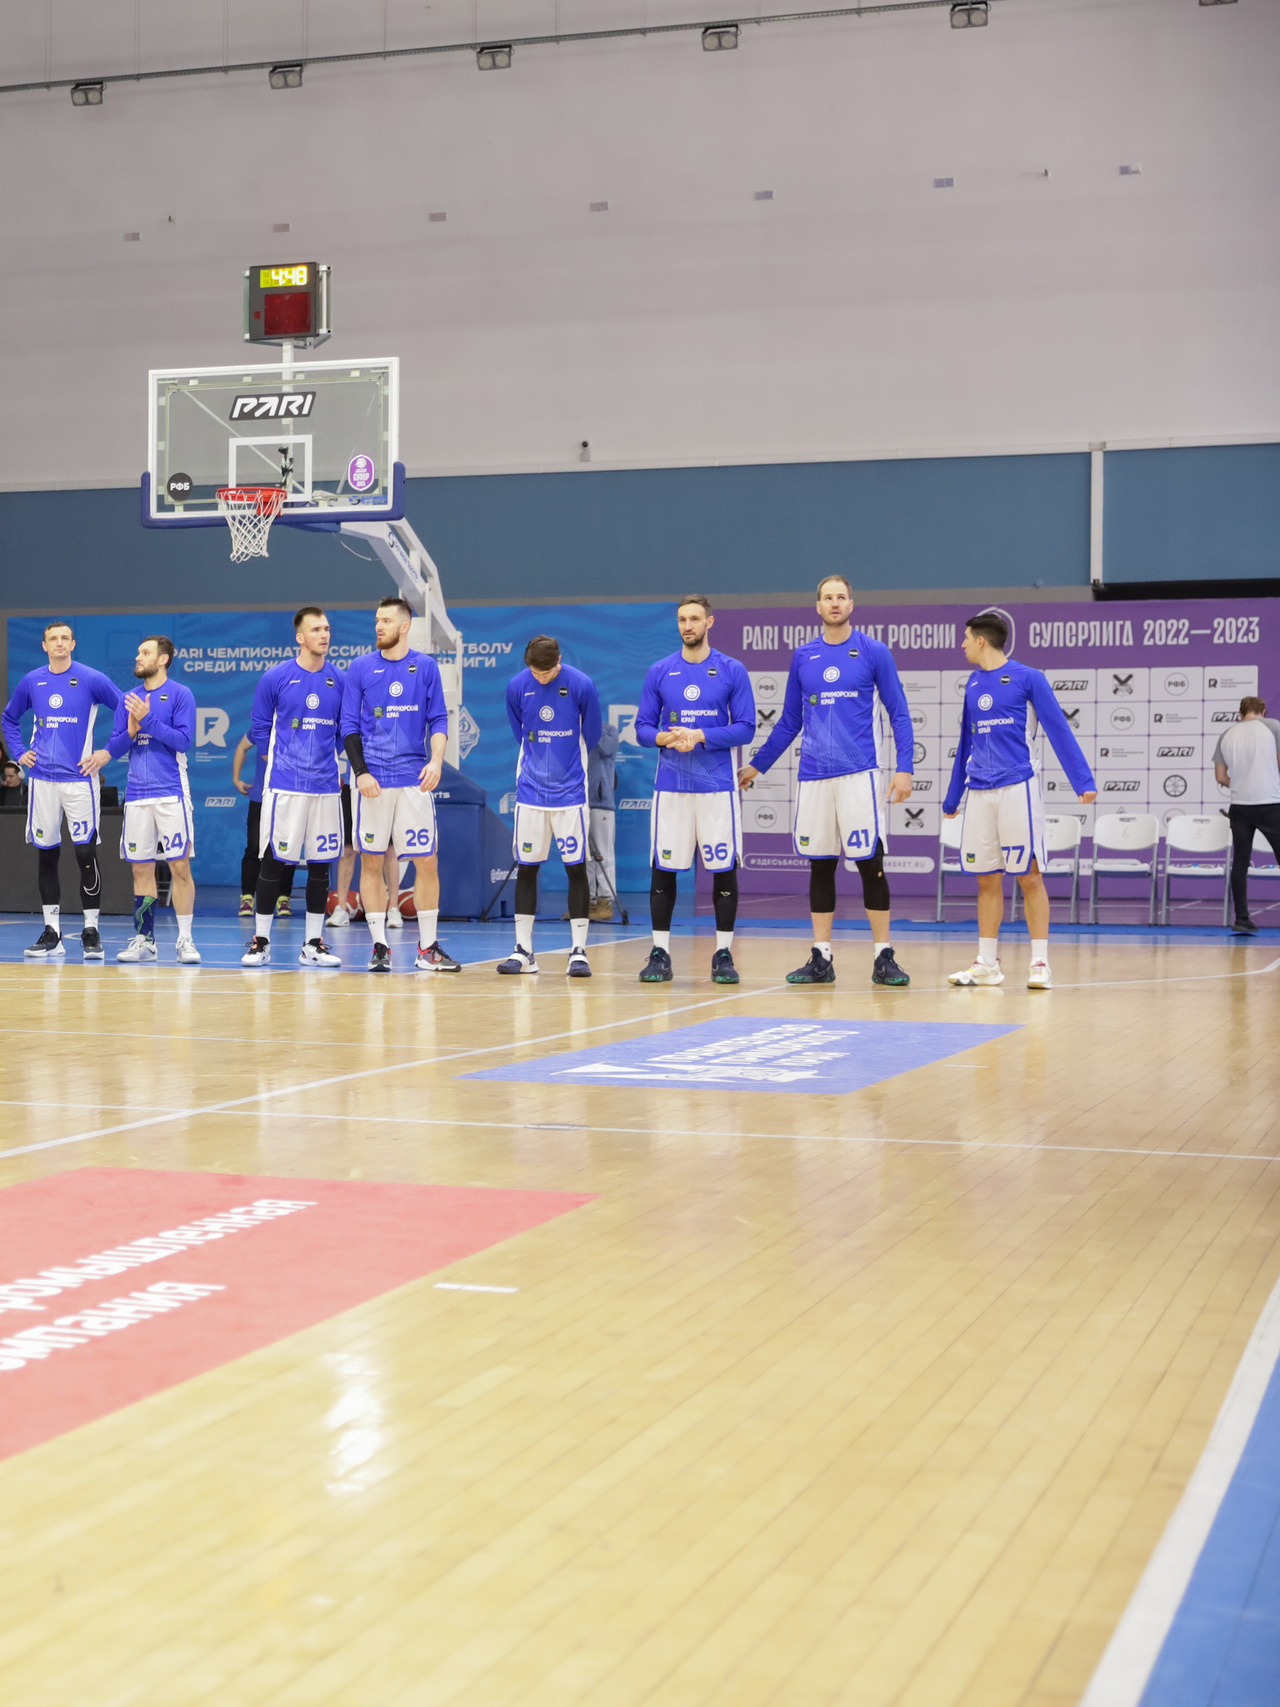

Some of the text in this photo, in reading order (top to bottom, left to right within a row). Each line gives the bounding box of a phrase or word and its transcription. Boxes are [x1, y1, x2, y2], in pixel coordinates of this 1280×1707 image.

[271, 265, 308, 287] 4:48
[231, 393, 313, 419] PARI
[170, 482, 190, 491] РФБ
[742, 625, 779, 651] PARI
[888, 623, 956, 650] РОССИИ
[1029, 620, 1134, 648] СУПЕРЛИГА
[207, 646, 302, 659] ЧЕМПИОНАТ
[183, 661, 236, 673] СРЕДИ
[1211, 711, 1242, 722] PAR
[206, 798, 235, 807] PARI
[72, 820, 88, 836] 21
[163, 832, 184, 851] 24
[316, 833, 339, 852] 25
[405, 829, 430, 847] 26
[556, 836, 578, 855] 29
[847, 829, 870, 848] 41
[703, 843, 728, 862] 36
[1001, 845, 1025, 865] 77
